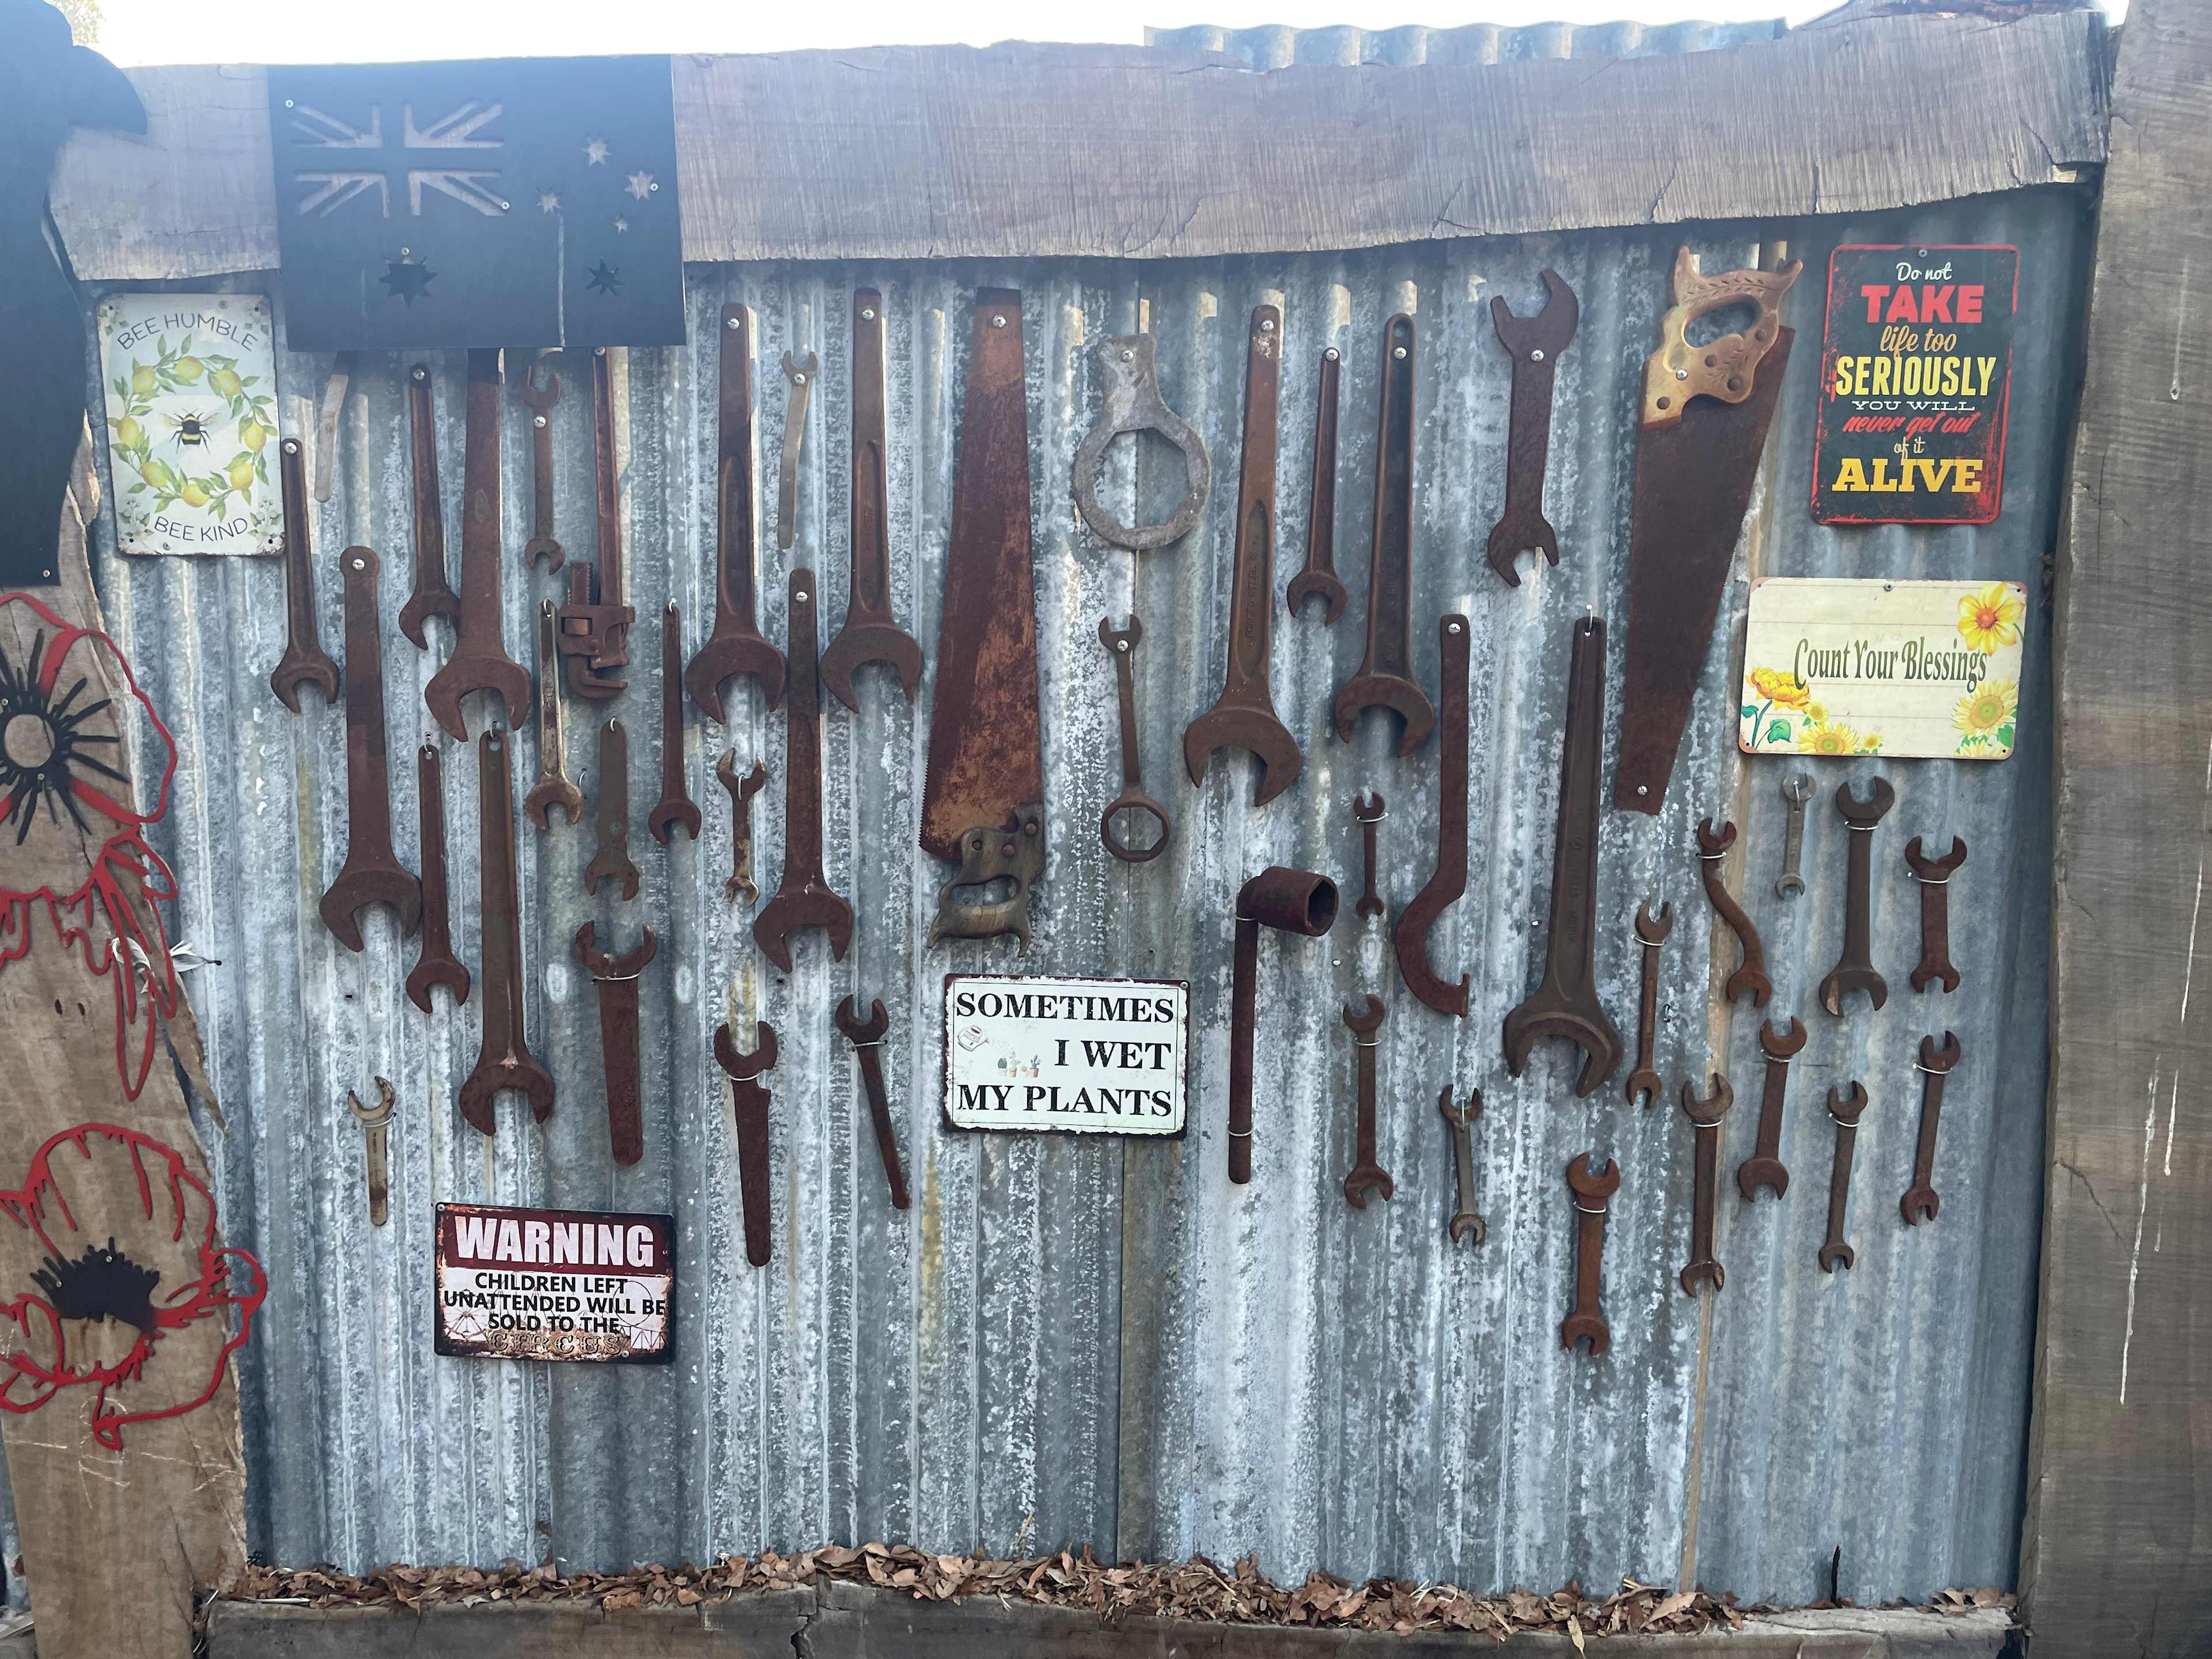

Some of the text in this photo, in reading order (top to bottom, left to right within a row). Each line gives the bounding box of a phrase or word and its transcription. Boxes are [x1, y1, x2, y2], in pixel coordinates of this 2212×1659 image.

[1896, 262, 1953, 282] Do not
[1861, 285, 1984, 323] TAKE
[117, 313, 259, 352] BEE HUMBLE
[1880, 325, 1957, 359] life too
[1835, 356, 1997, 396] SERIOUSLY
[1851, 401, 1975, 411] YOU WILL
[1842, 411, 1982, 442] never get out
[1893, 436, 1926, 460] of it
[1832, 458, 1983, 493] ALIVE
[154, 516, 248, 542] BEE KIND
[1794, 637, 1987, 693] Count Your Blessings
[956, 993, 1174, 1023] SOMETIMES
[1054, 1039, 1171, 1070] I WET
[957, 1084, 1172, 1117] MY PLANTS
[454, 1215, 654, 1268] WARNING
[475, 1272, 628, 1294] CHILDREN LEFT
[444, 1290, 665, 1316] UNATTENDED WILL BE
[488, 1313, 619, 1334] SOLD TO THE
[487, 1332, 622, 1355] CIRCUS
